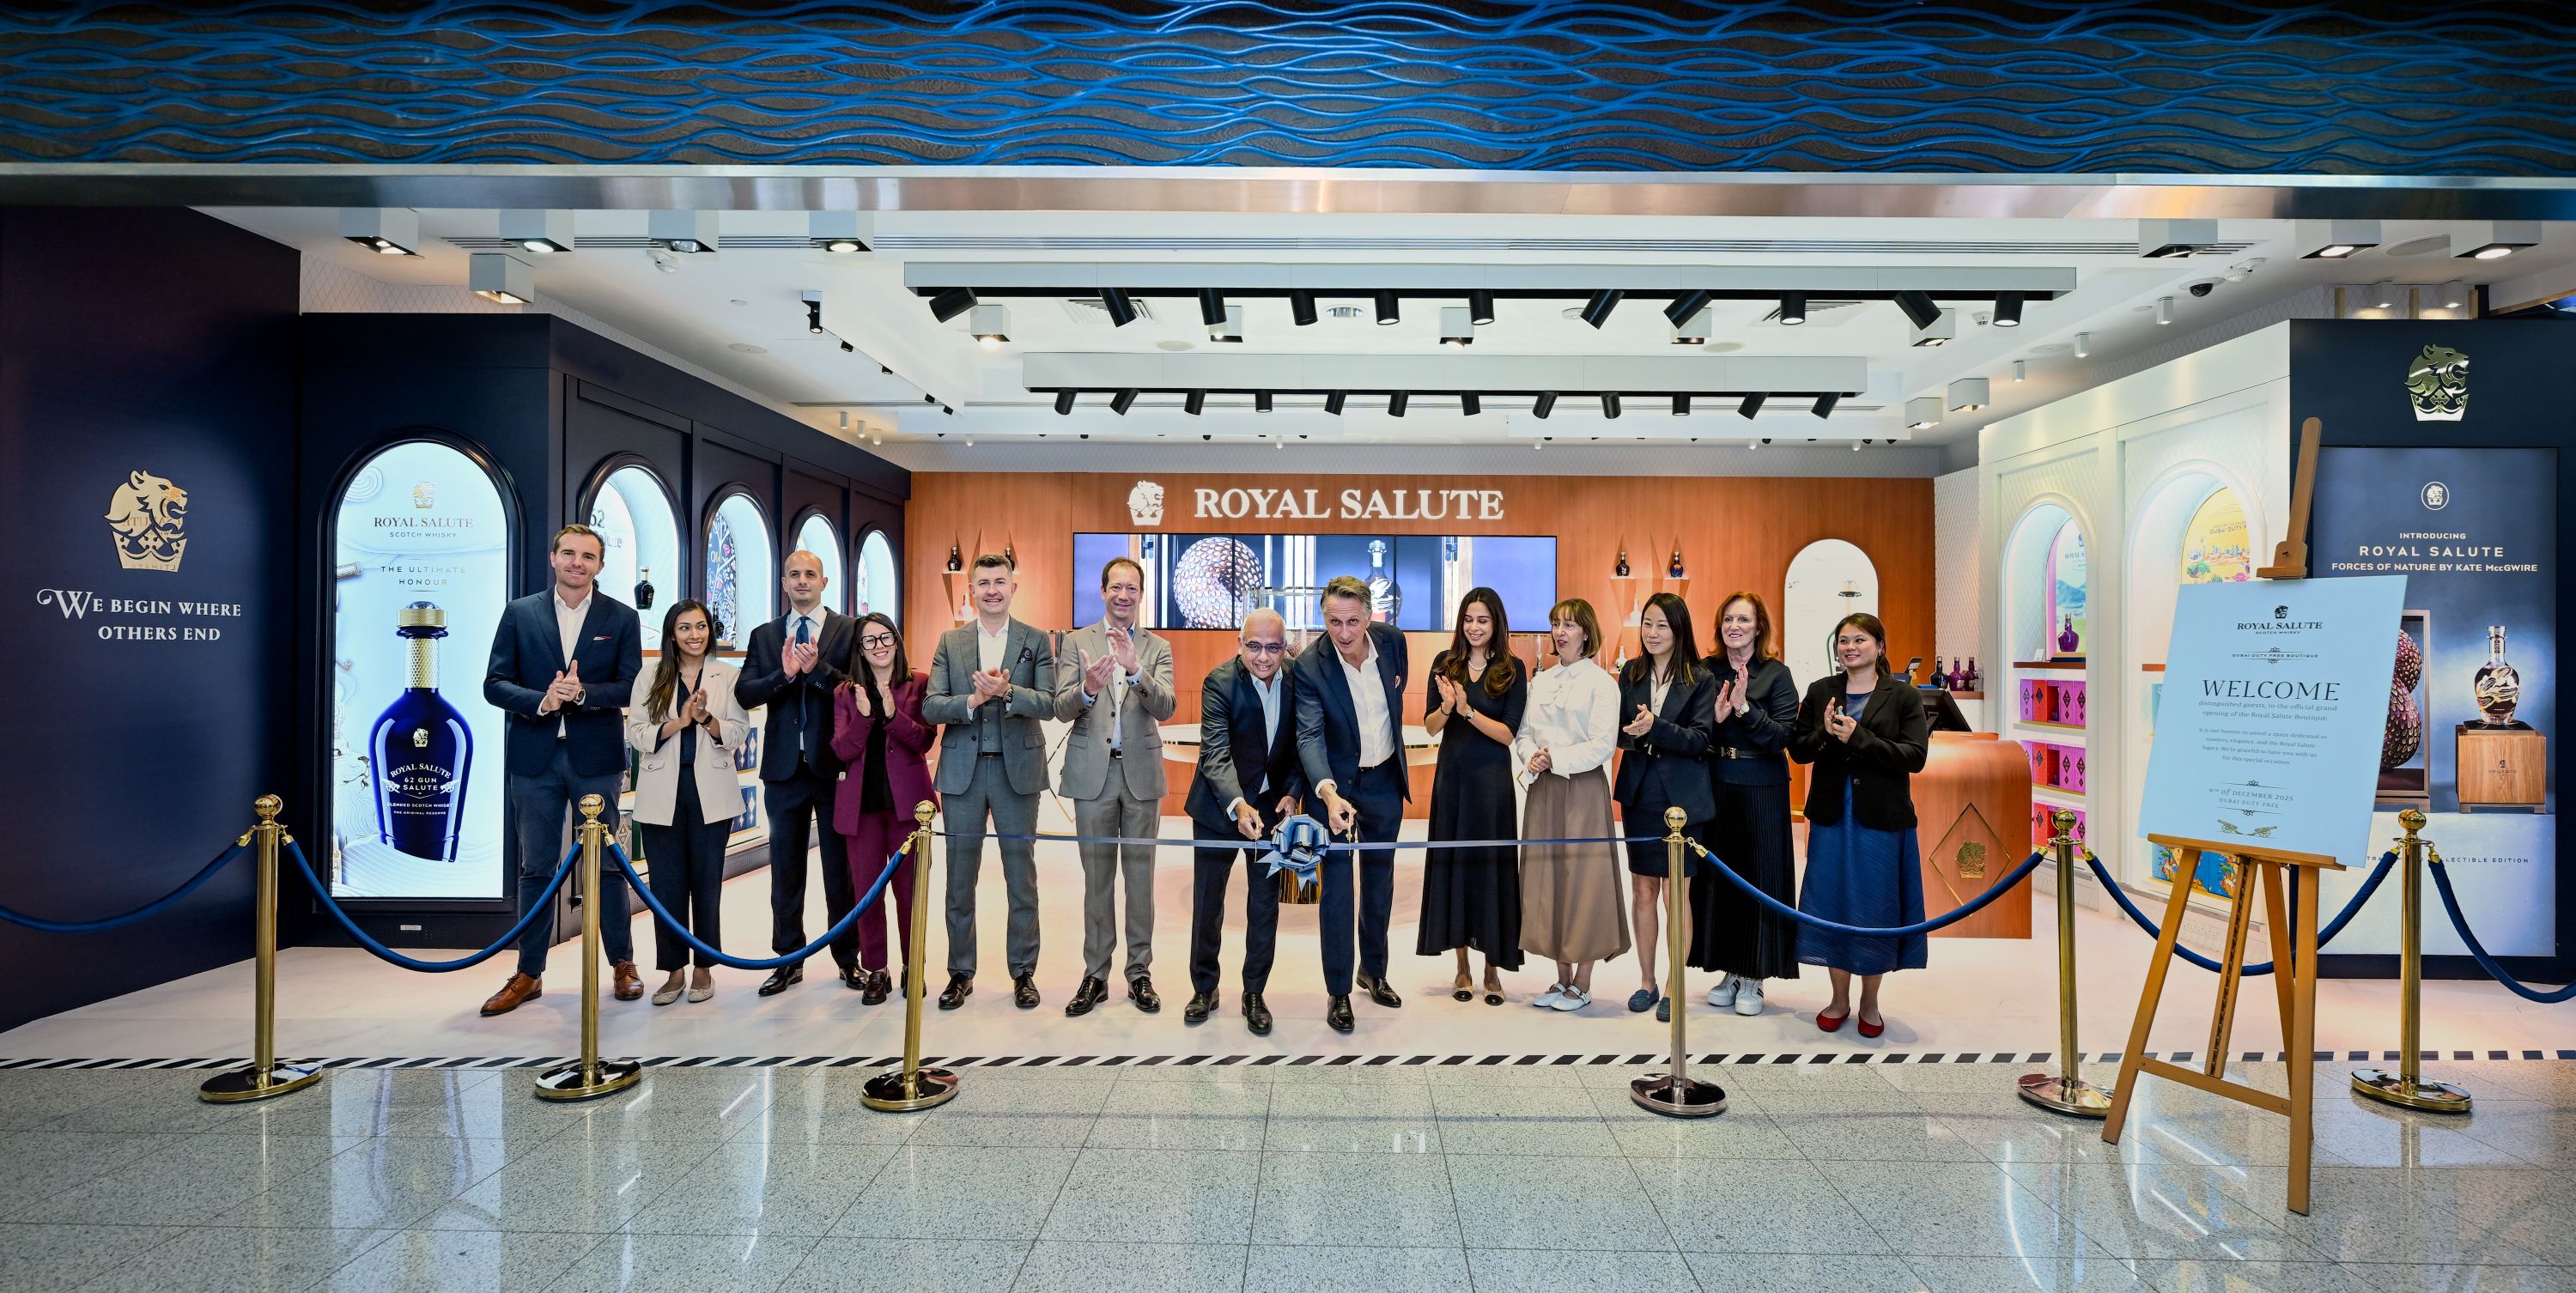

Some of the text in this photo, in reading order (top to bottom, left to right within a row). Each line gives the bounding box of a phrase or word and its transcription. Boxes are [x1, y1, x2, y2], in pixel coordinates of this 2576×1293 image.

[1194, 488, 1504, 519] ROYAL SALUTE
[374, 517, 474, 528] ROYAL SALUTE
[2359, 545, 2504, 557] ROYAL SALUTE
[2331, 562, 2374, 571] FORCES
[2376, 562, 2391, 571] OF
[2456, 563, 2482, 572] KATE
[36, 588, 241, 619] WE BEGIN WHERE
[98, 626, 221, 640] OTHERS END
[2202, 679, 2341, 701] WELCOME
[2294, 713, 2329, 722] Boutique.
[390, 762, 452, 779] ROYAL SALUTE
[2232, 790, 2273, 799] DECEMBER
[2242, 798, 2259, 807] DUTY
